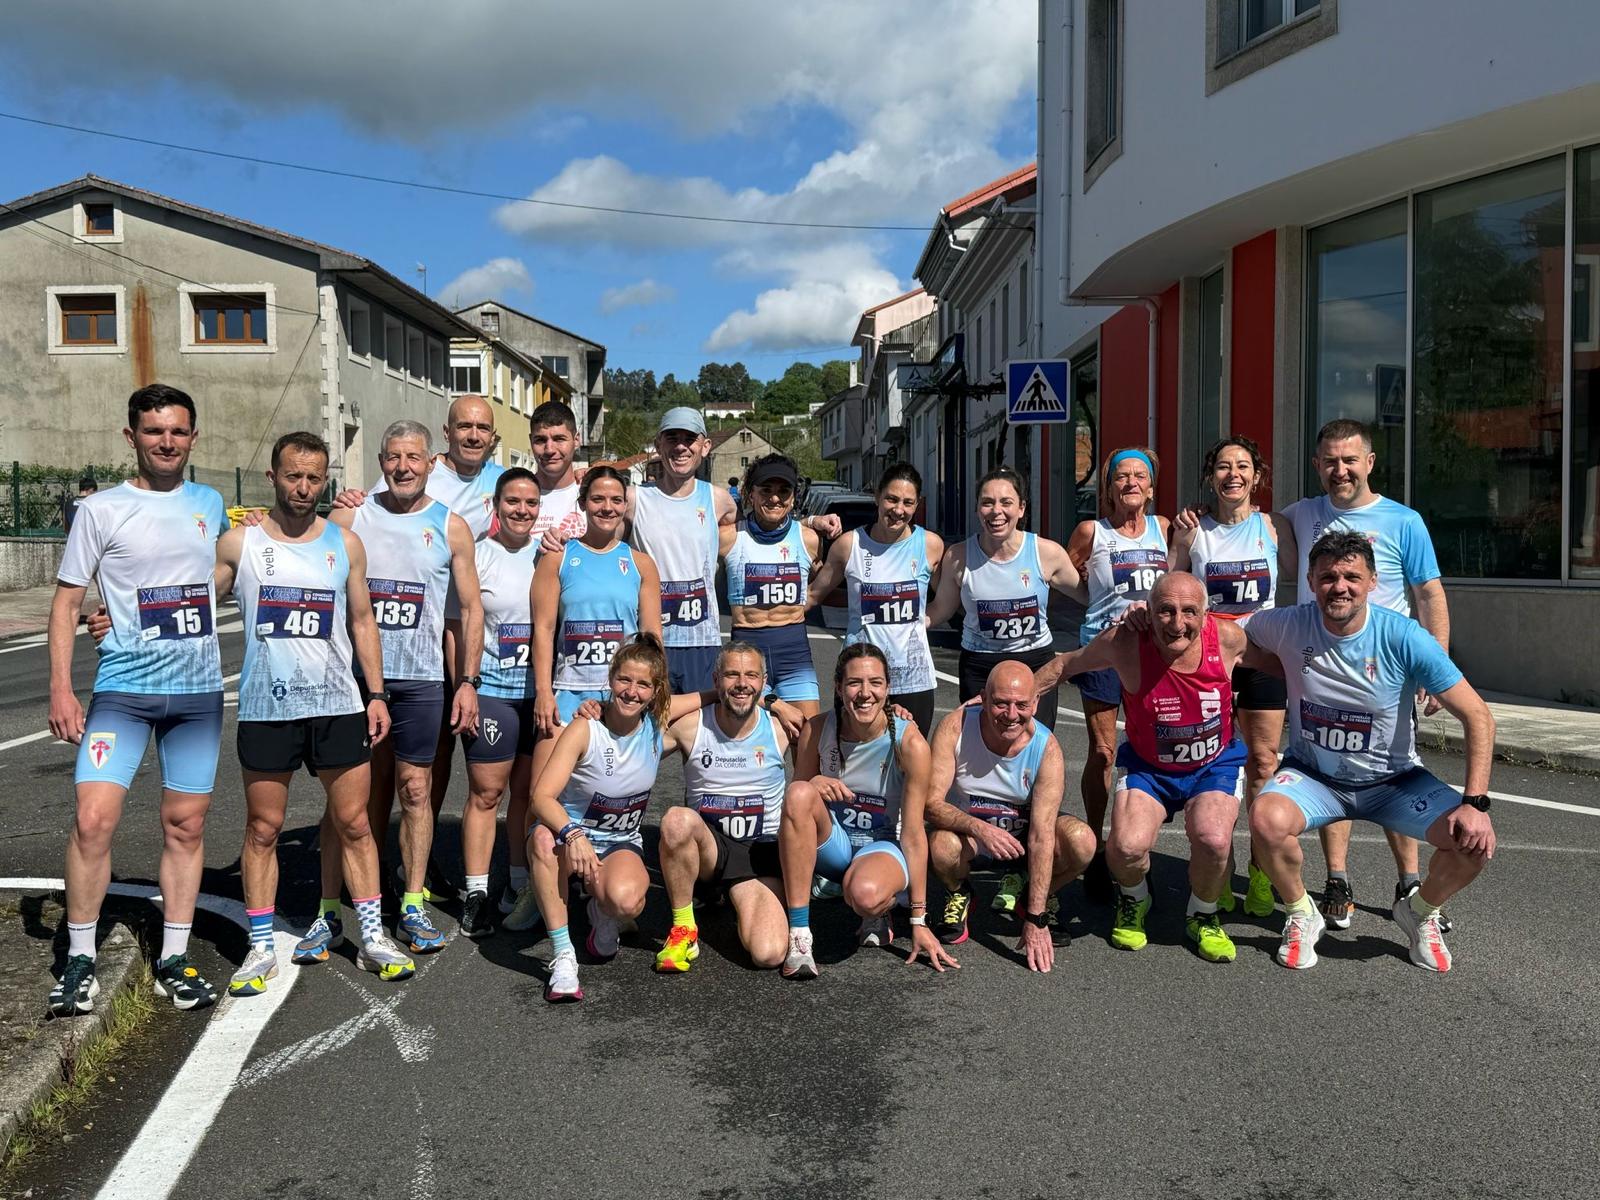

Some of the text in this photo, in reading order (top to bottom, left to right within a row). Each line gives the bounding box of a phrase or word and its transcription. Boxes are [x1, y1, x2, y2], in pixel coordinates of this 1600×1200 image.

[1312, 520, 1321, 543] velb
[262, 547, 274, 577] evelb
[864, 552, 873, 577] evelb
[760, 582, 797, 604] 159
[1232, 580, 1260, 602] 74
[172, 608, 202, 635] 15
[373, 600, 417, 626] 133
[678, 599, 702, 622] 48
[880, 600, 914, 622] 114
[284, 610, 320, 636] 46
[994, 616, 1036, 639] 232
[517, 644, 530, 666] 2
[1302, 646, 1314, 675] evelb
[1174, 734, 1219, 763] 205
[1316, 726, 1364, 751] 108
[604, 747, 614, 777] evelb
[599, 809, 642, 831] 243
[719, 816, 758, 838] 107
[842, 808, 873, 830] 26
